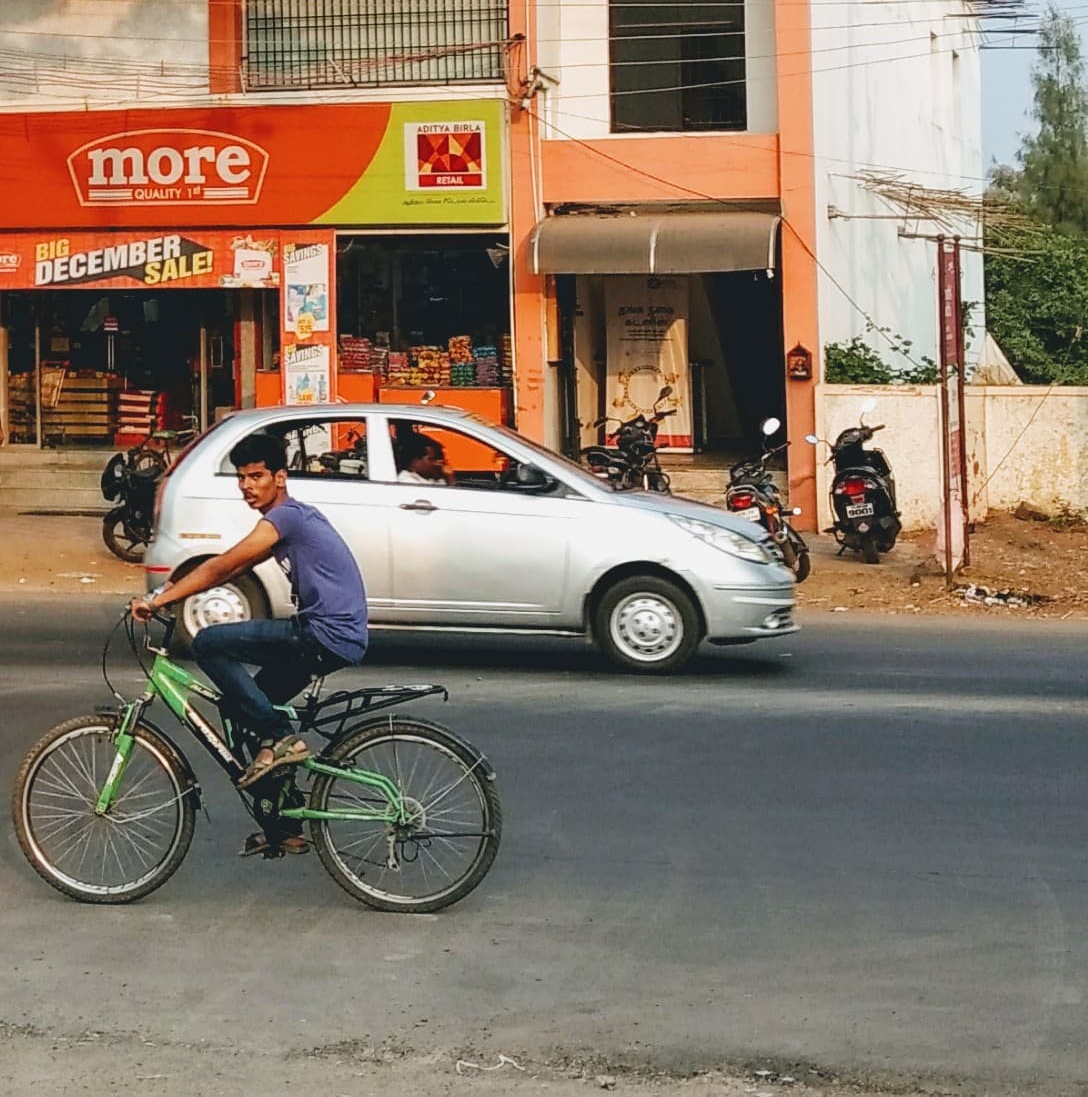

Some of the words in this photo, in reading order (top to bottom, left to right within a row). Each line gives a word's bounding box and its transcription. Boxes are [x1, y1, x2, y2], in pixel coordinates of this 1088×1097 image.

[416, 123, 450, 133] ADITYA
[453, 123, 482, 133] BIRLA
[87, 145, 251, 186] more
[436, 176, 465, 186] RETAIL
[134, 187, 182, 201] QUALITY
[34, 234, 181, 287] DECEMBER
[35, 238, 71, 262] BIG
[282, 243, 323, 264] SAVINGS
[143, 250, 214, 286] SALE!
[284, 343, 323, 365] SAVINGS
